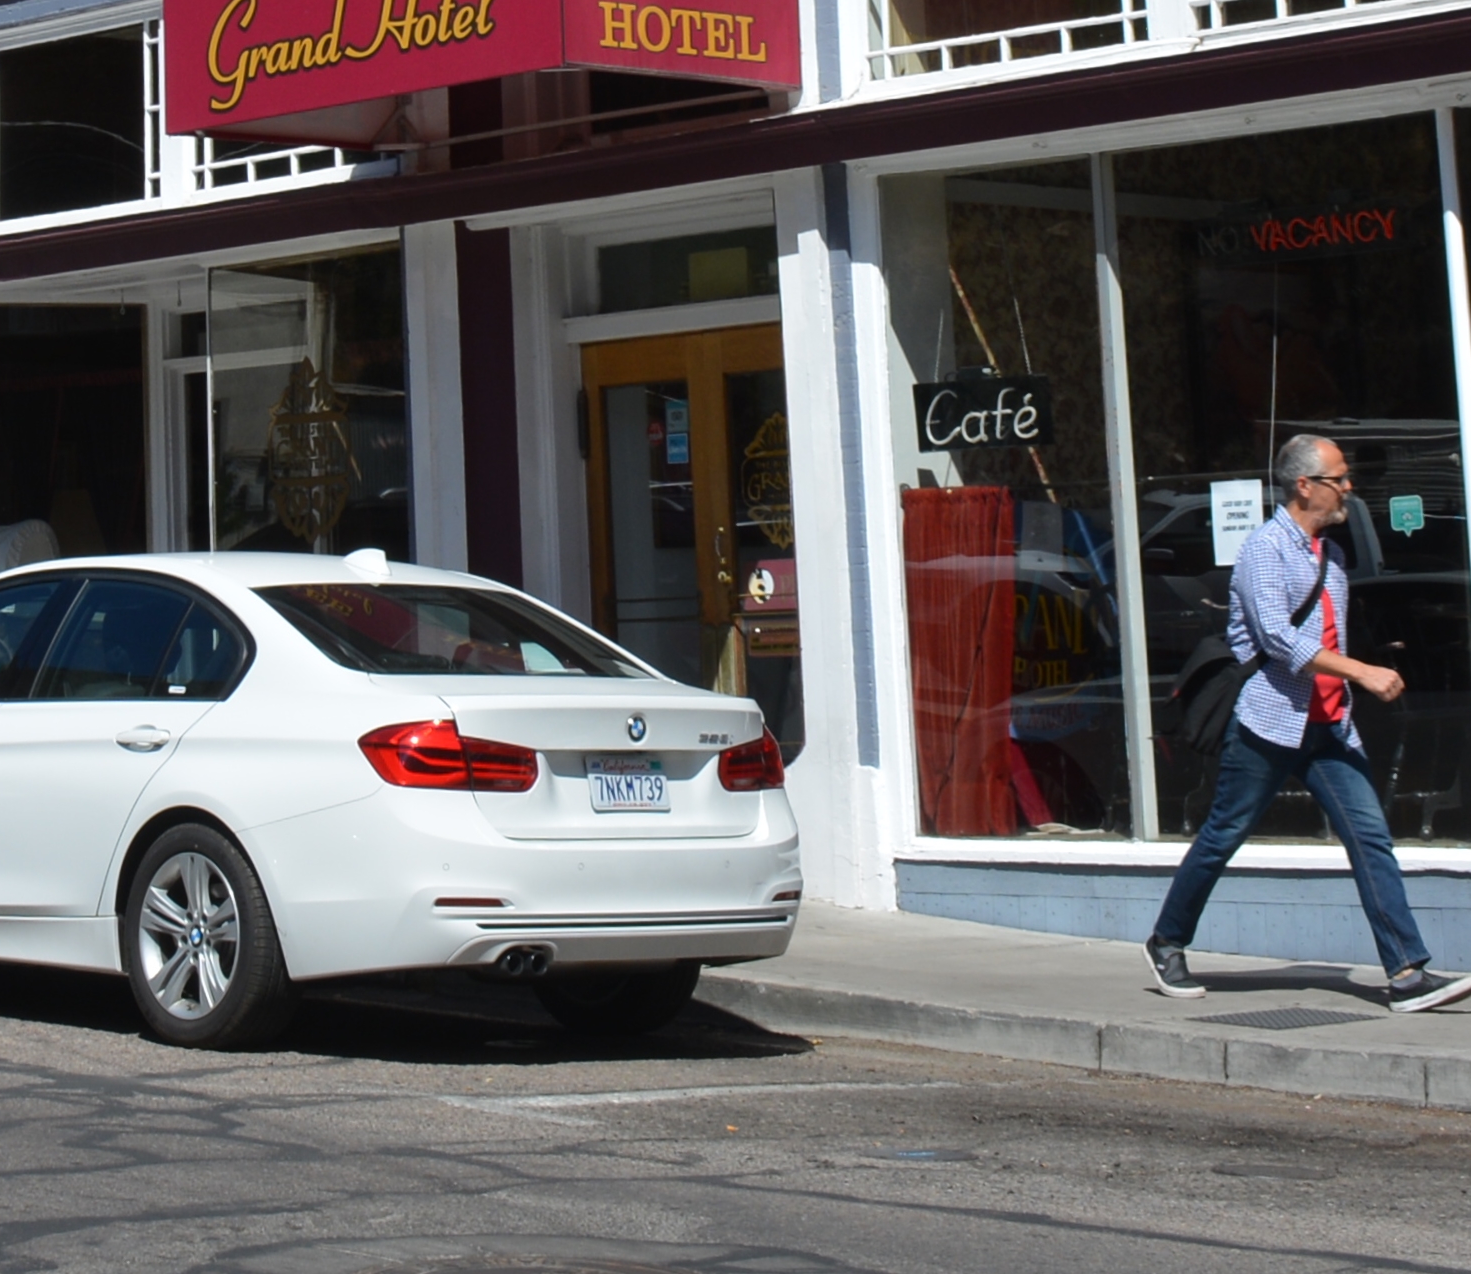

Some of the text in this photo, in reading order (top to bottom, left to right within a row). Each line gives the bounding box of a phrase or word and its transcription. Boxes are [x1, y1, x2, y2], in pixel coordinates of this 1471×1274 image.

[597, 0, 768, 64] HOTEL
[1250, 209, 1396, 251] VACANCY
[925, 386, 1040, 446] Café
[747, 472, 790, 501] GRA
[594, 776, 663, 802] 7NKM739
